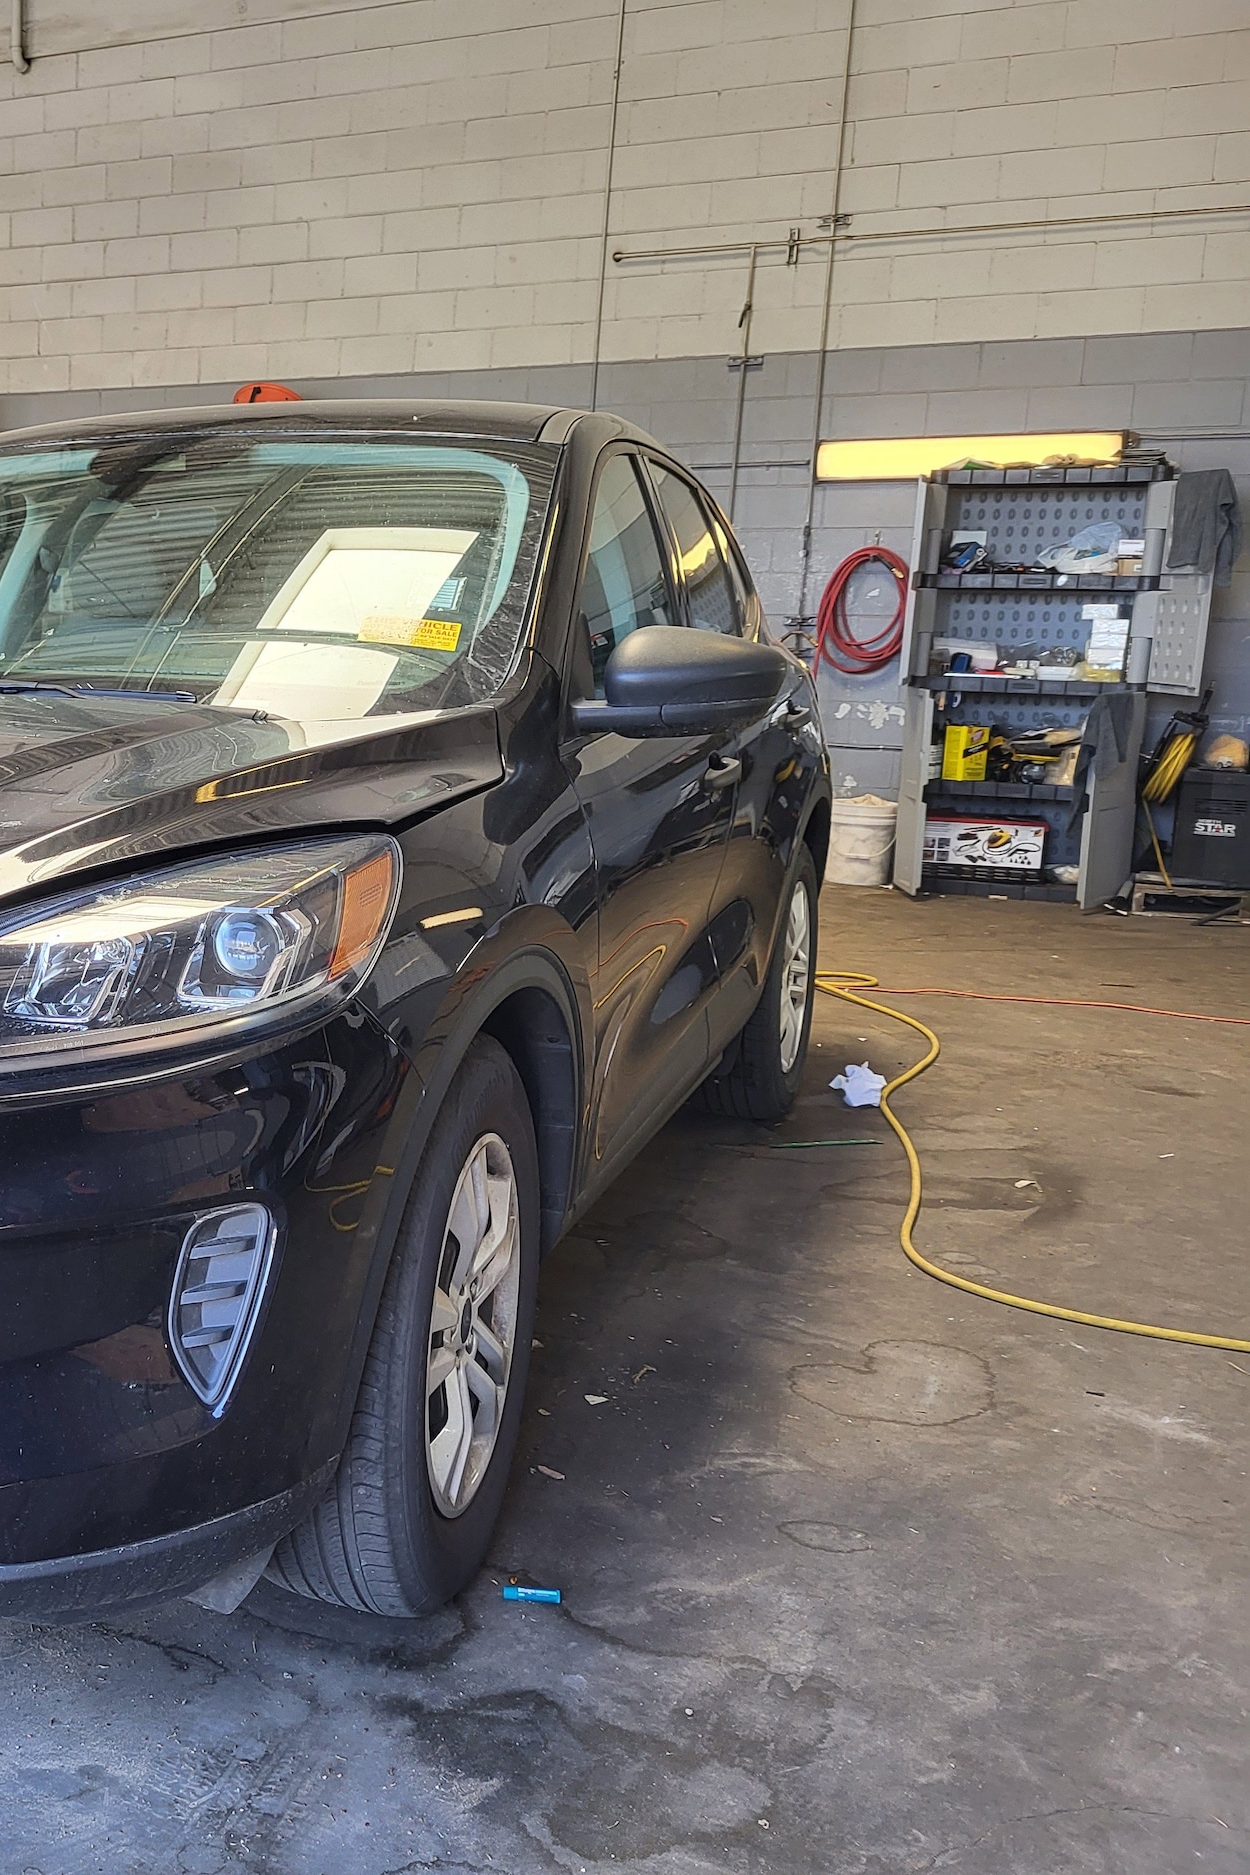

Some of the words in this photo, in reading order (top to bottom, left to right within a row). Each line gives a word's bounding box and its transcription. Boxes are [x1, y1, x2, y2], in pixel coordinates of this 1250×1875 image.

[415, 627, 434, 635] FOR
[435, 629, 458, 637] SALE
[1194, 822, 1236, 834] STAR
